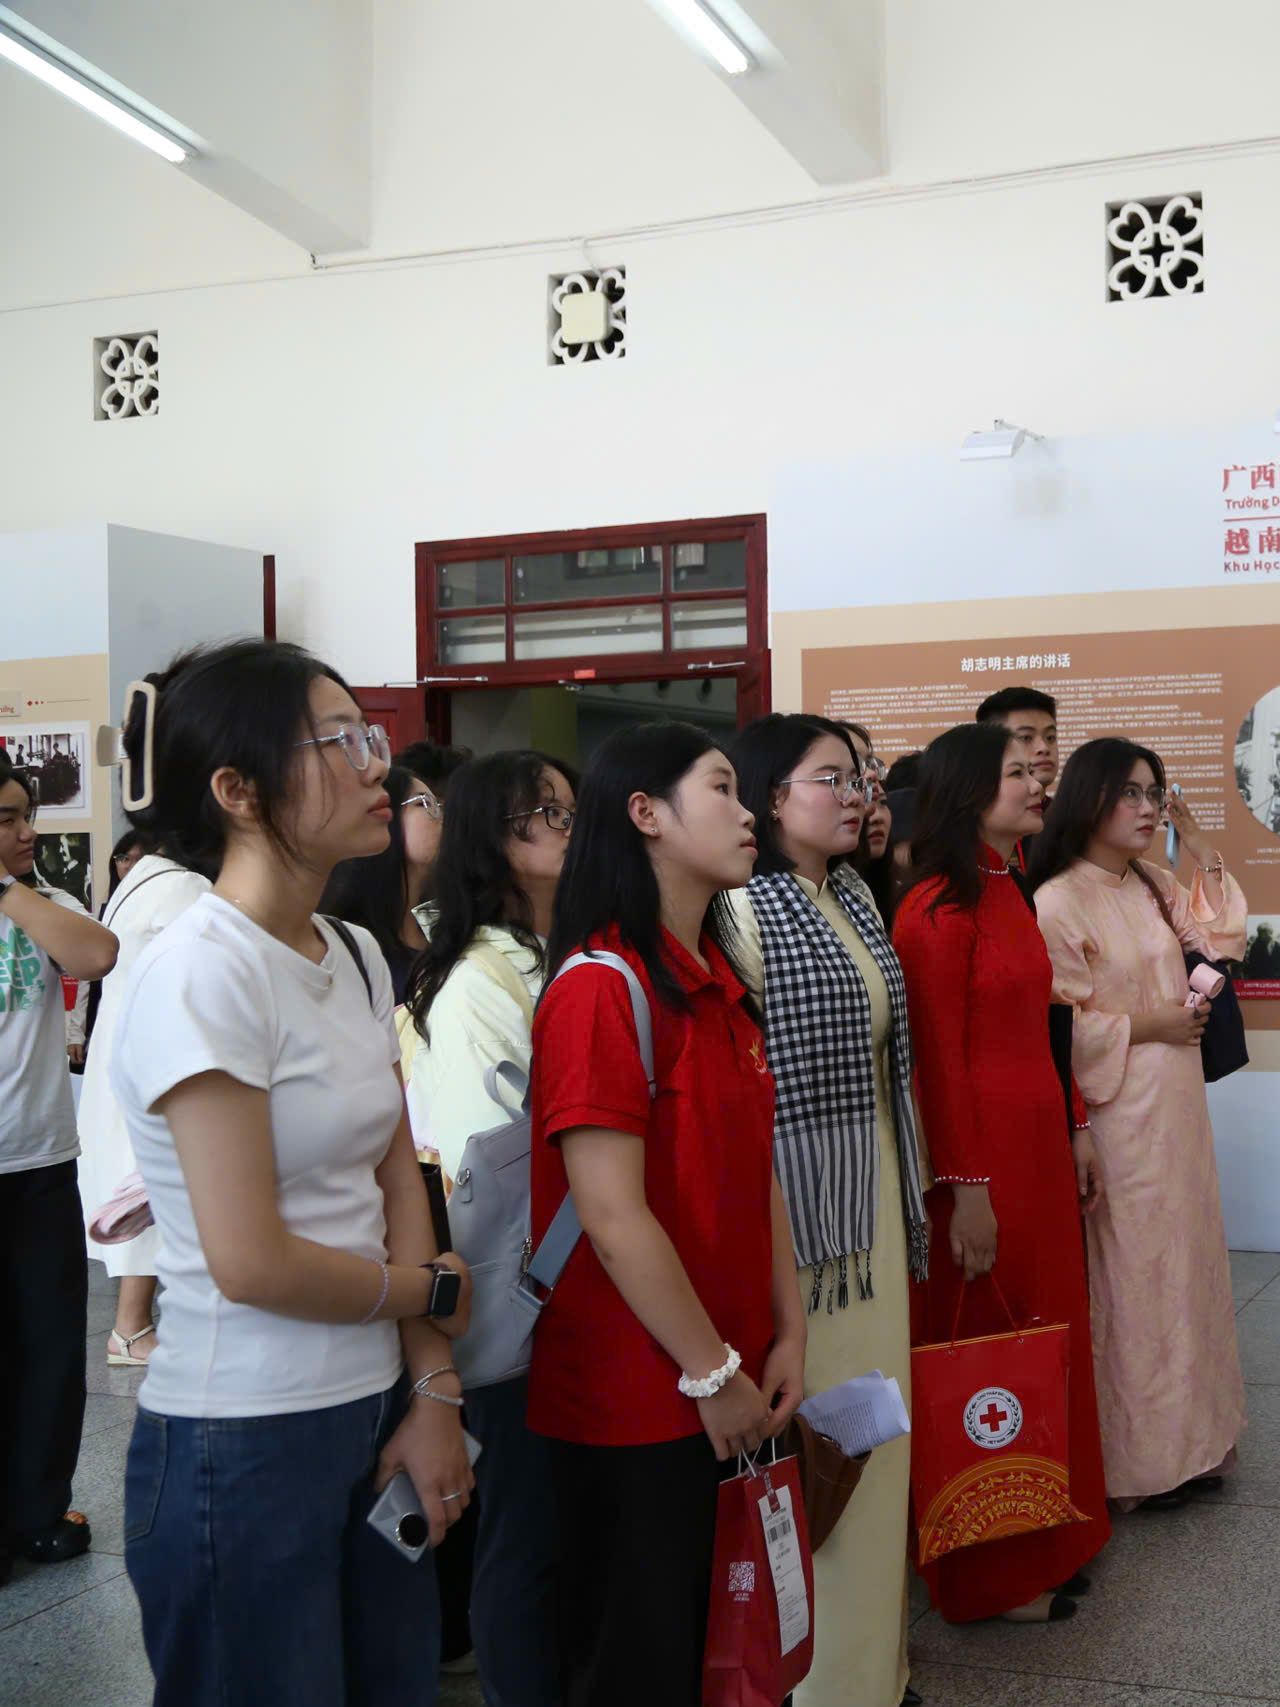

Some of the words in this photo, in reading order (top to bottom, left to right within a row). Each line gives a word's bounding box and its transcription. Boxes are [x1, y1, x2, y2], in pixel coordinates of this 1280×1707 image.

[1225, 495, 1270, 511] Trường
[1223, 560, 1250, 573] Khu
[1254, 558, 1280, 574] Học
[960, 652, 1071, 674] 胡志明主席的讲话
